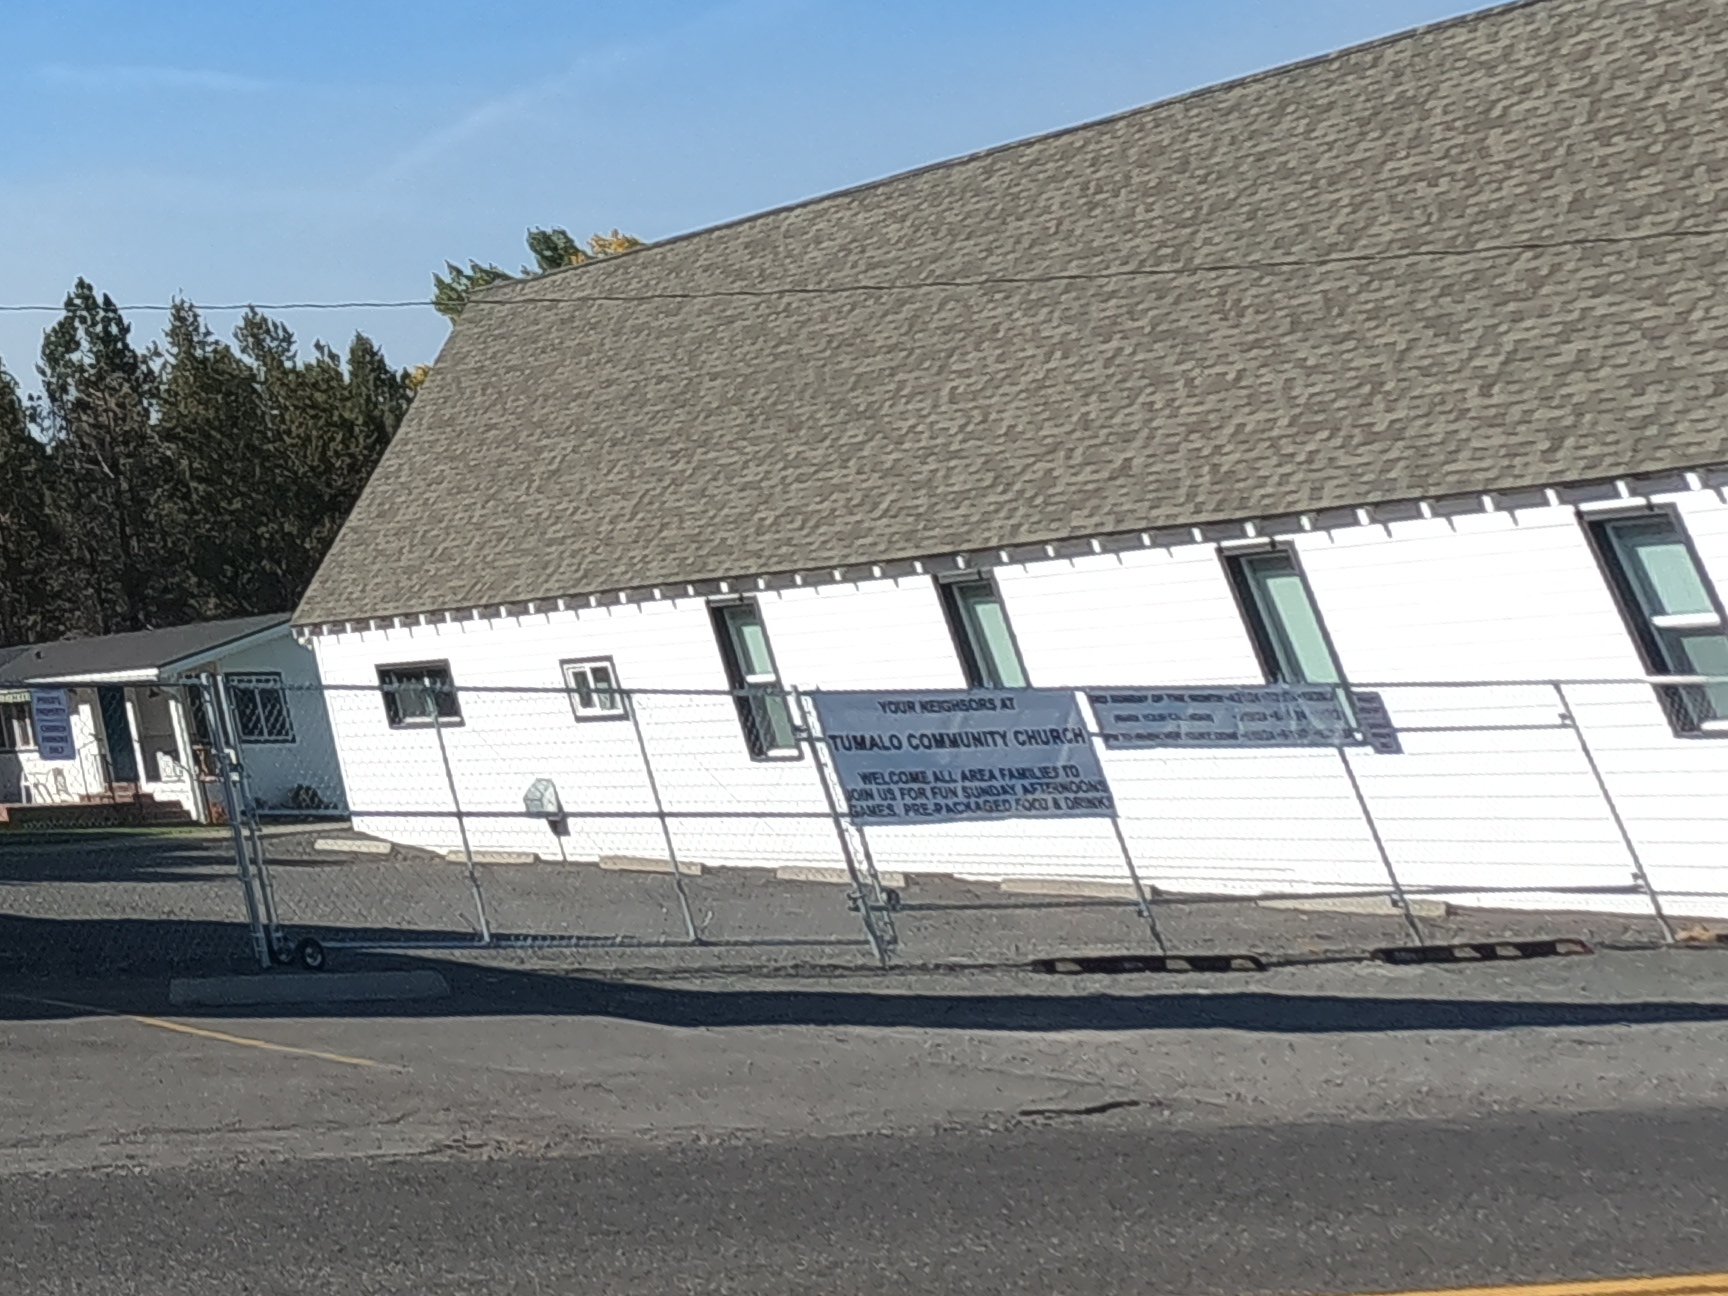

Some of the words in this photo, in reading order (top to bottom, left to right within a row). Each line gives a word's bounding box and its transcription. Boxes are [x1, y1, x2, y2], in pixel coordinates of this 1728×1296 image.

[878, 700, 917, 714] YOUR
[1000, 696, 1015, 710] AT
[828, 733, 903, 752] TUMALO
[907, 729, 1009, 750] COMMUNITY
[1013, 727, 1086, 746] CHURCH
[857, 769, 931, 786] WELCOME
[932, 769, 958, 783] ALL
[960, 767, 998, 782] AREA
[998, 766, 1059, 781] FAMILIES
[1061, 764, 1080, 778] TO
[877, 787, 897, 801] US
[899, 787, 930, 801] FOR
[930, 785, 959, 799] FUN
[962, 783, 1017, 799] SUNDAY
